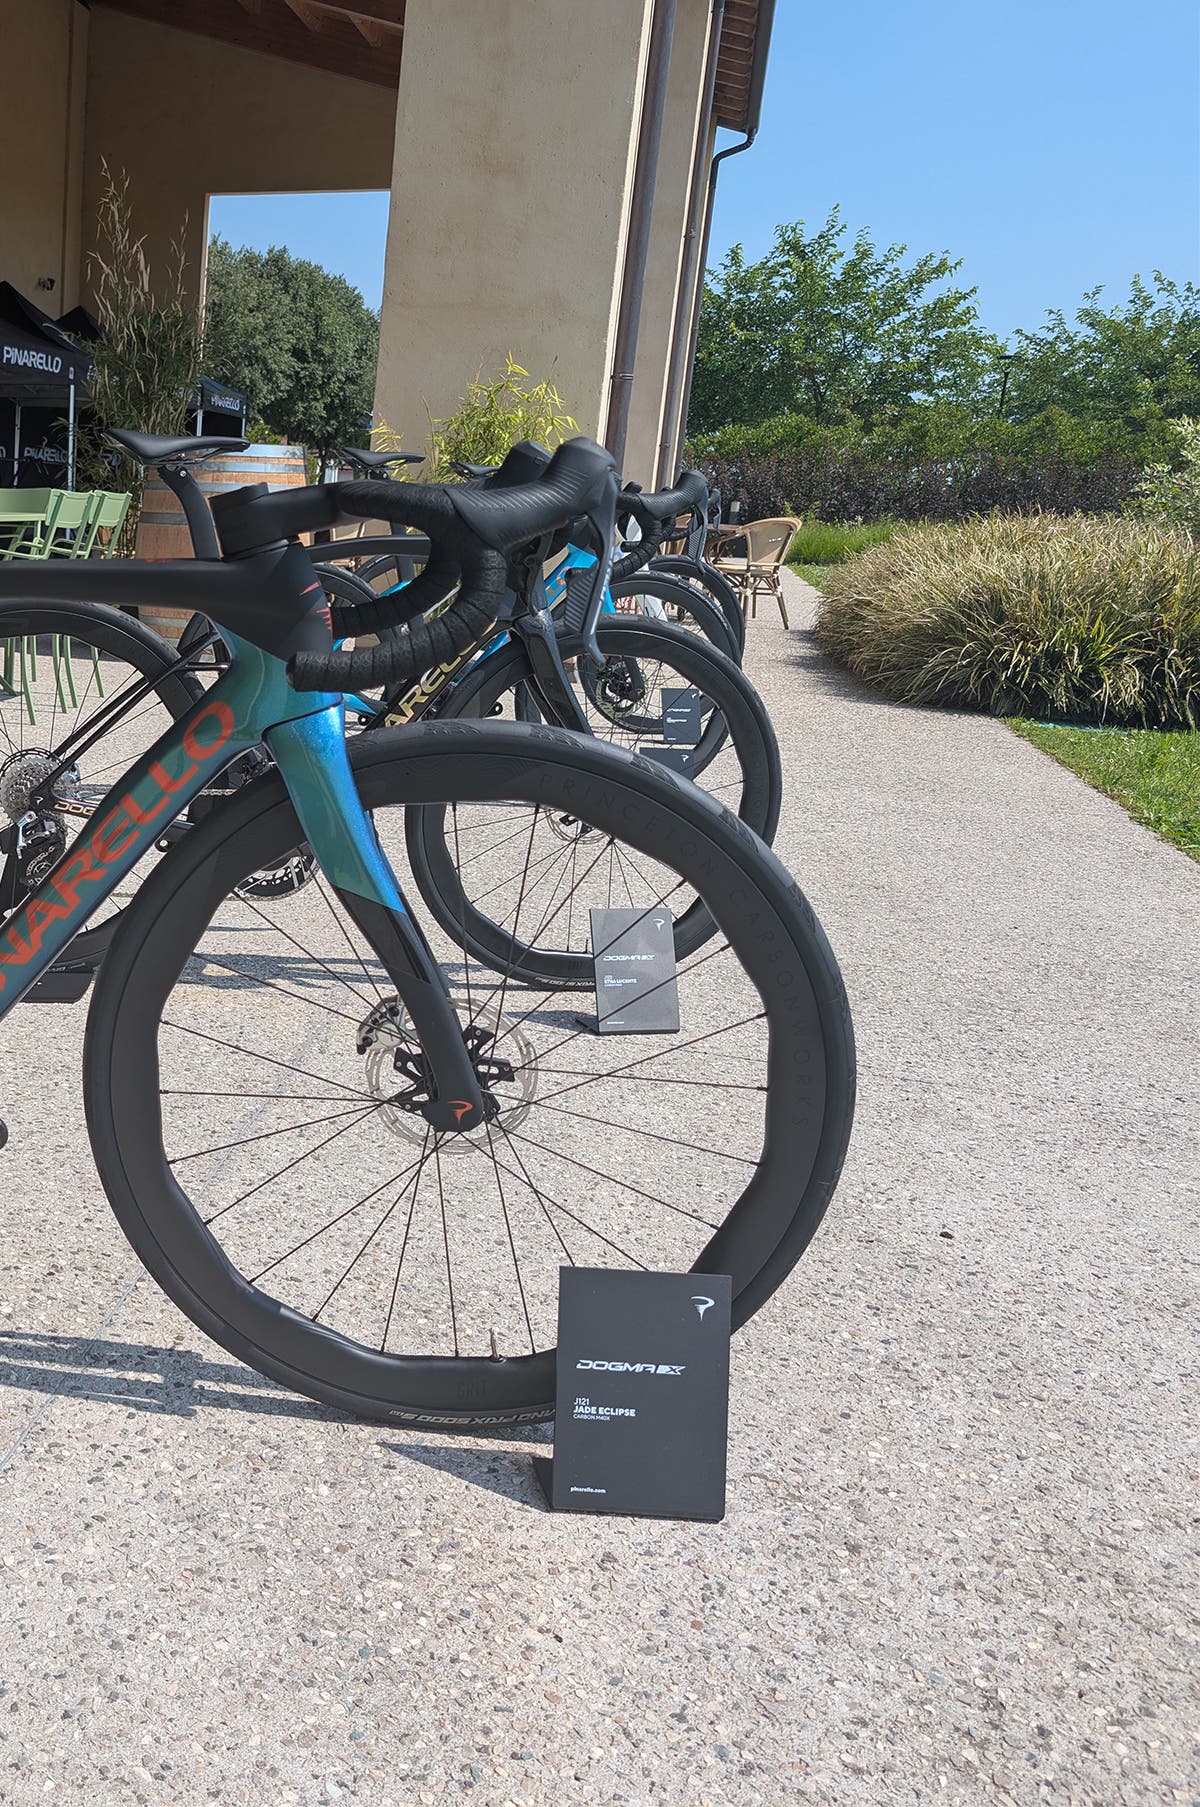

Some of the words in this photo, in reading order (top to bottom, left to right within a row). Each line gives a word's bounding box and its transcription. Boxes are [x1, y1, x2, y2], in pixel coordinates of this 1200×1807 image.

[2, 346, 62, 373] PINARELLO
[54, 800, 97, 816] DOG
[518, 1408, 556, 1421] AND
[573, 1405, 597, 1415] JADE
[598, 1407, 636, 1417] ECLIPSE
[418, 1413, 471, 1425] 5000
